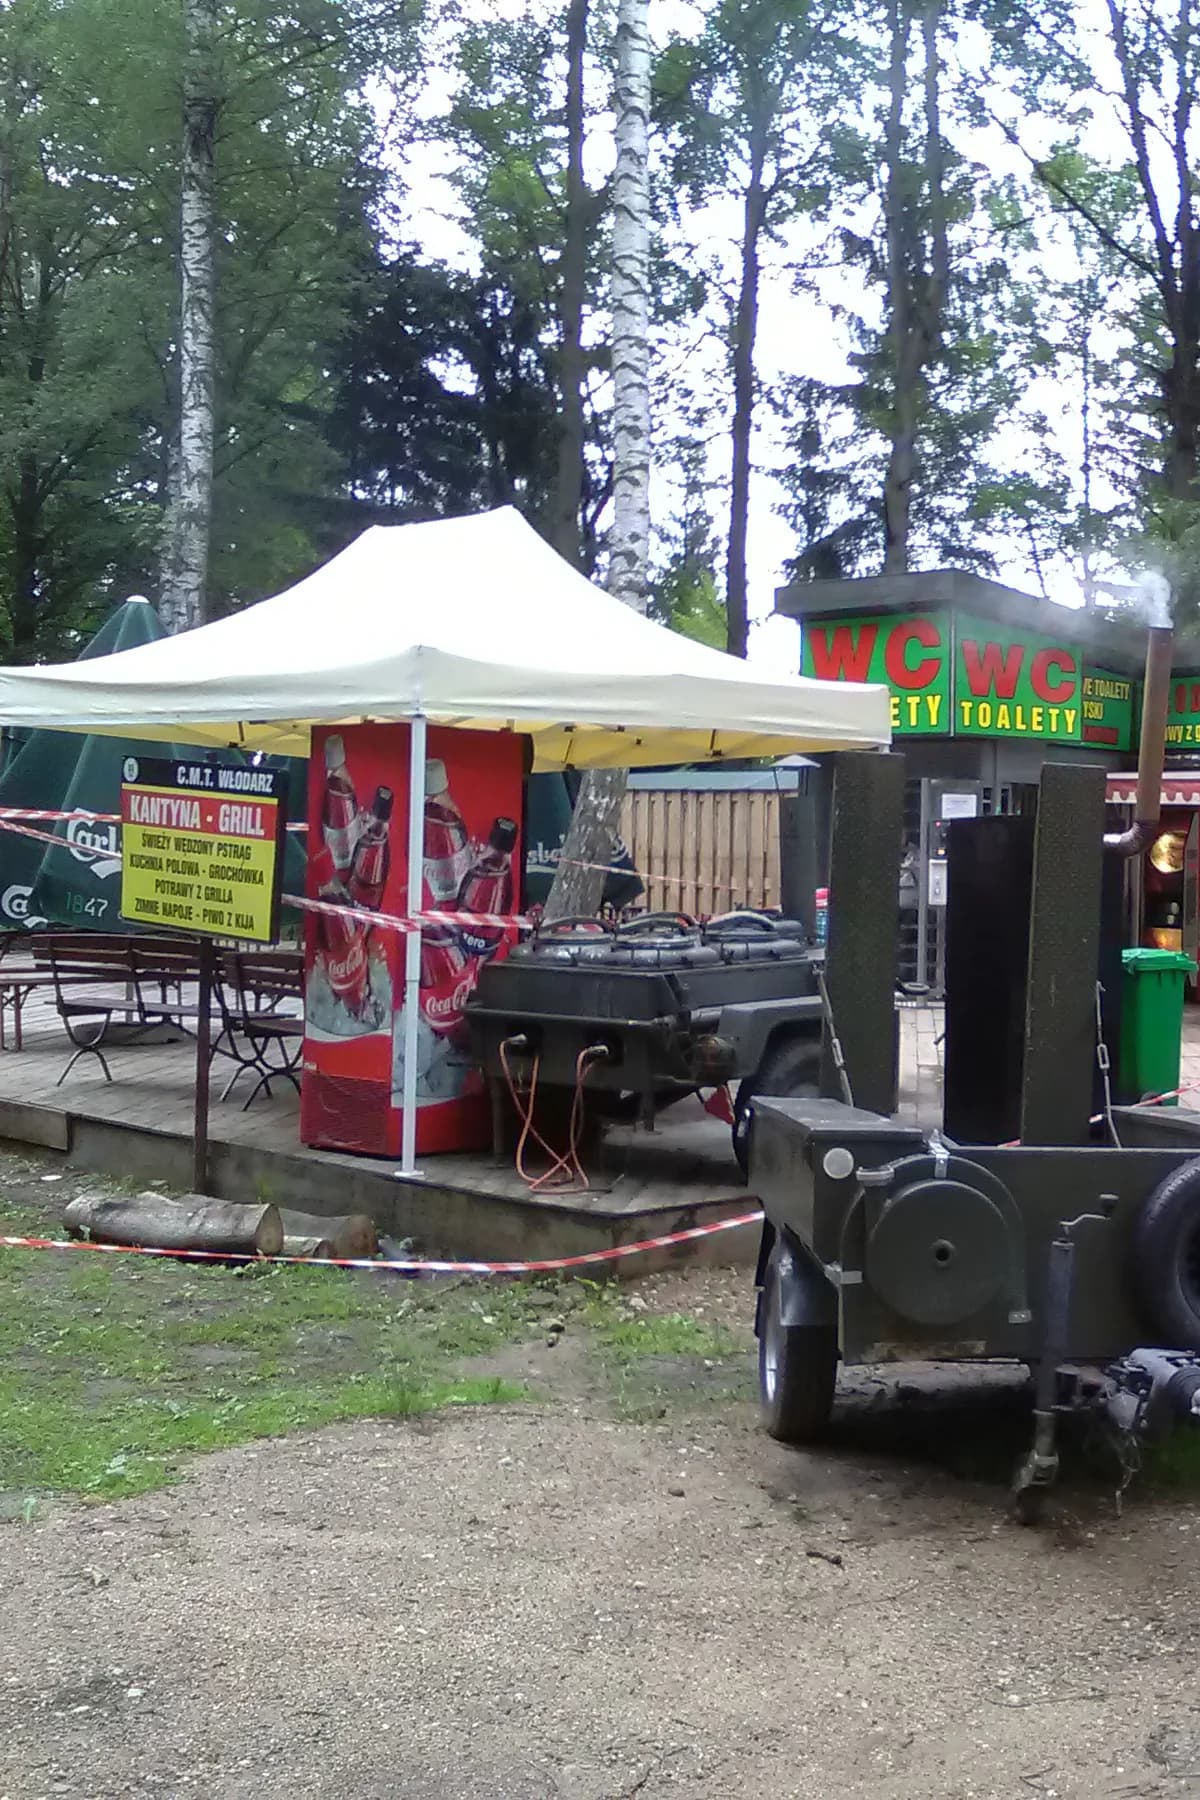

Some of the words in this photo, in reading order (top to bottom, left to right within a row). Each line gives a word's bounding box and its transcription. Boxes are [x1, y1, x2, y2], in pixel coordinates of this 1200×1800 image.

[808, 618, 944, 689] WC
[960, 638, 1076, 704] WC
[960, 700, 1078, 735] TOALETY
[177, 766, 213, 787] C.M.T.
[218, 770, 273, 793] WŁODARZ
[129, 794, 201, 829] KANTYNA
[218, 803, 265, 836] GRILL
[66, 808, 118, 863] Carl
[129, 853, 163, 873] KUCHNIA
[166, 860, 200, 877] POLOWA
[154, 878, 194, 899] POTRAWY
[204, 888, 234, 906] GRILLA
